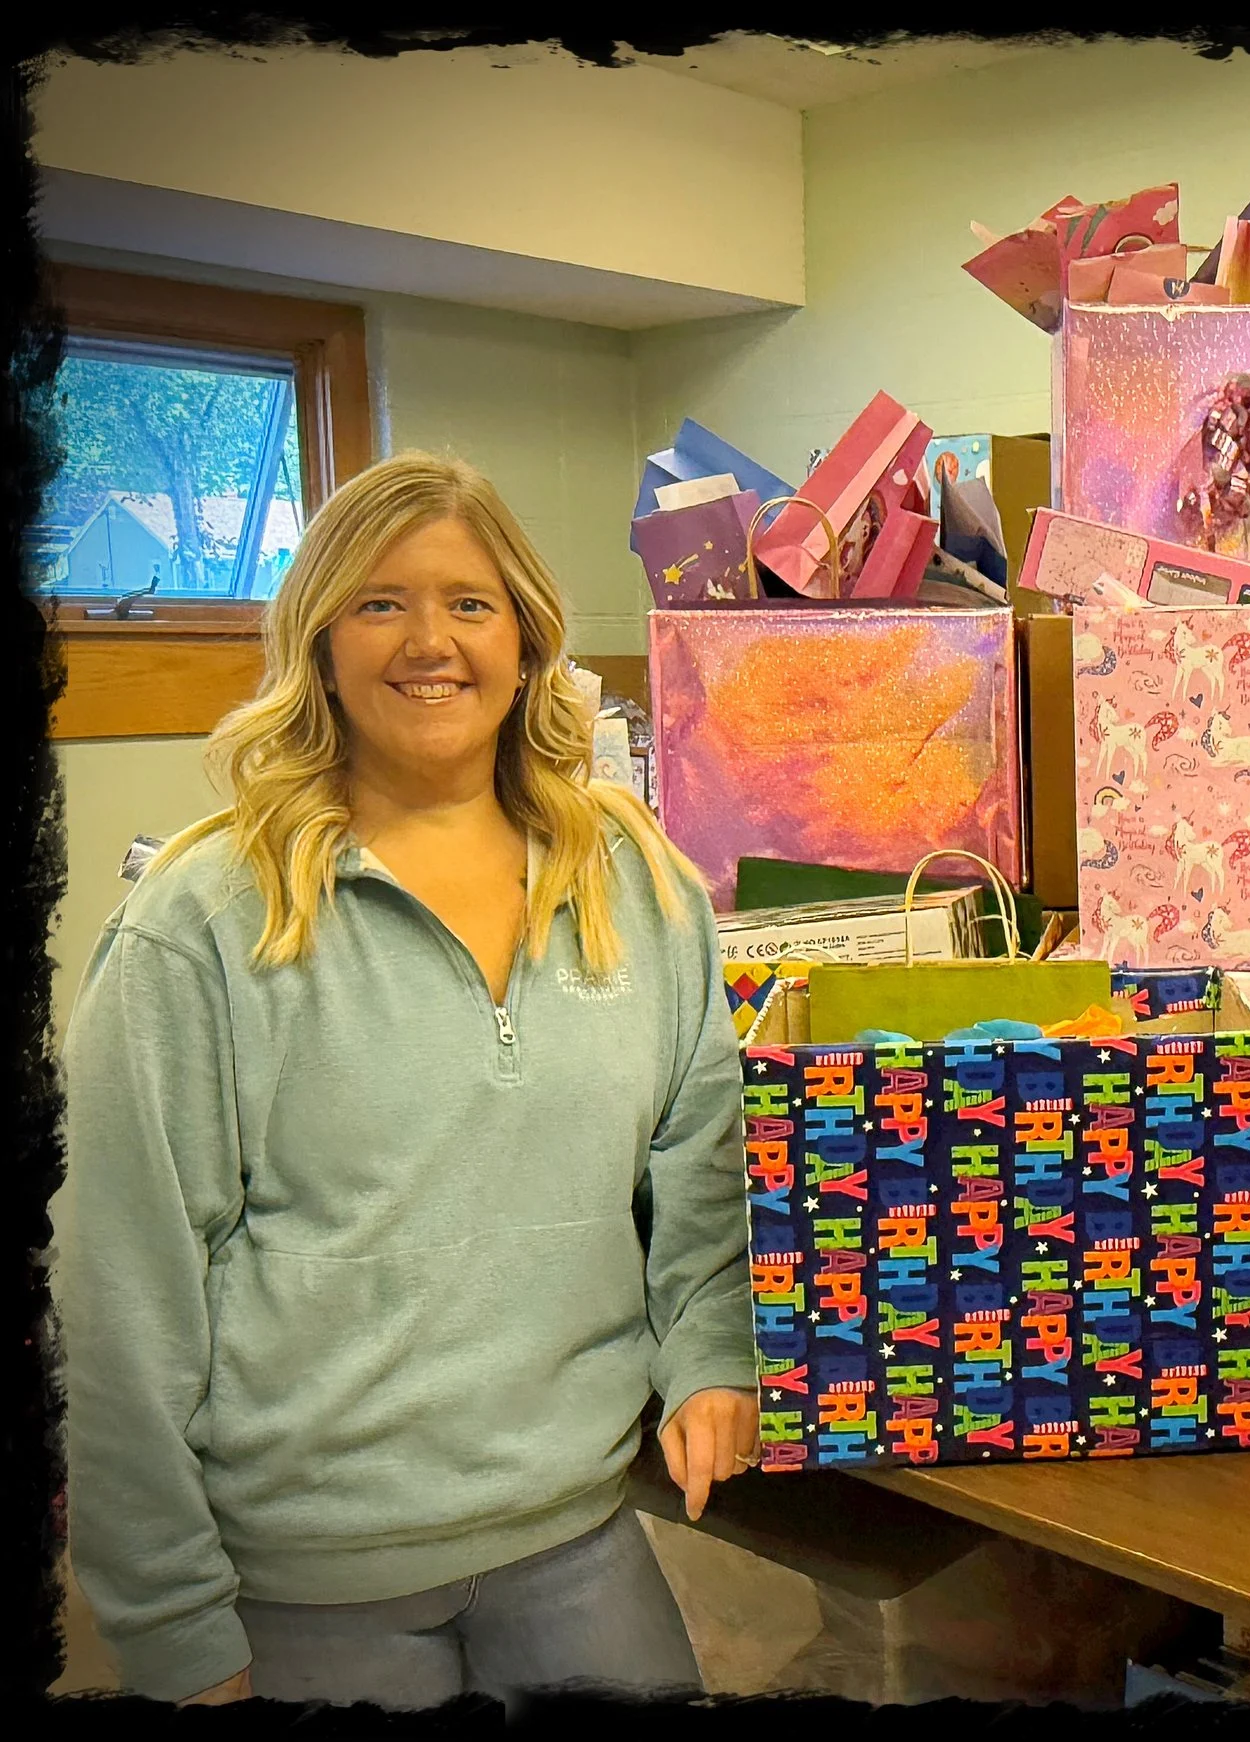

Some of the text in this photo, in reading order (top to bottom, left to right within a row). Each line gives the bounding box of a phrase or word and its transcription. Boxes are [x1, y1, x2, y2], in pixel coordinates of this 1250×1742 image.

[744, 1084, 794, 1215] HAPPY
[804, 1050, 868, 1200] IRTHDAY
[1013, 1072, 1075, 1244] BIRTHDAY
[1083, 1073, 1135, 1201] HAPPY
[1144, 1038, 1206, 1187] IRTHDAY
[813, 1218, 867, 1345] HAPPY
[874, 1041, 940, 1464] HAPPY BIRTHDAY HAPP
[951, 1145, 1004, 1273] HAPPY
[1150, 1203, 1201, 1329] HAPPY
[752, 1225, 808, 1394] BIRTHDAY
[953, 1284, 1015, 1450] BIRTHDAY
[1021, 1260, 1073, 1385] HAPPY
[1082, 1211, 1142, 1379] BIRTHDAY
